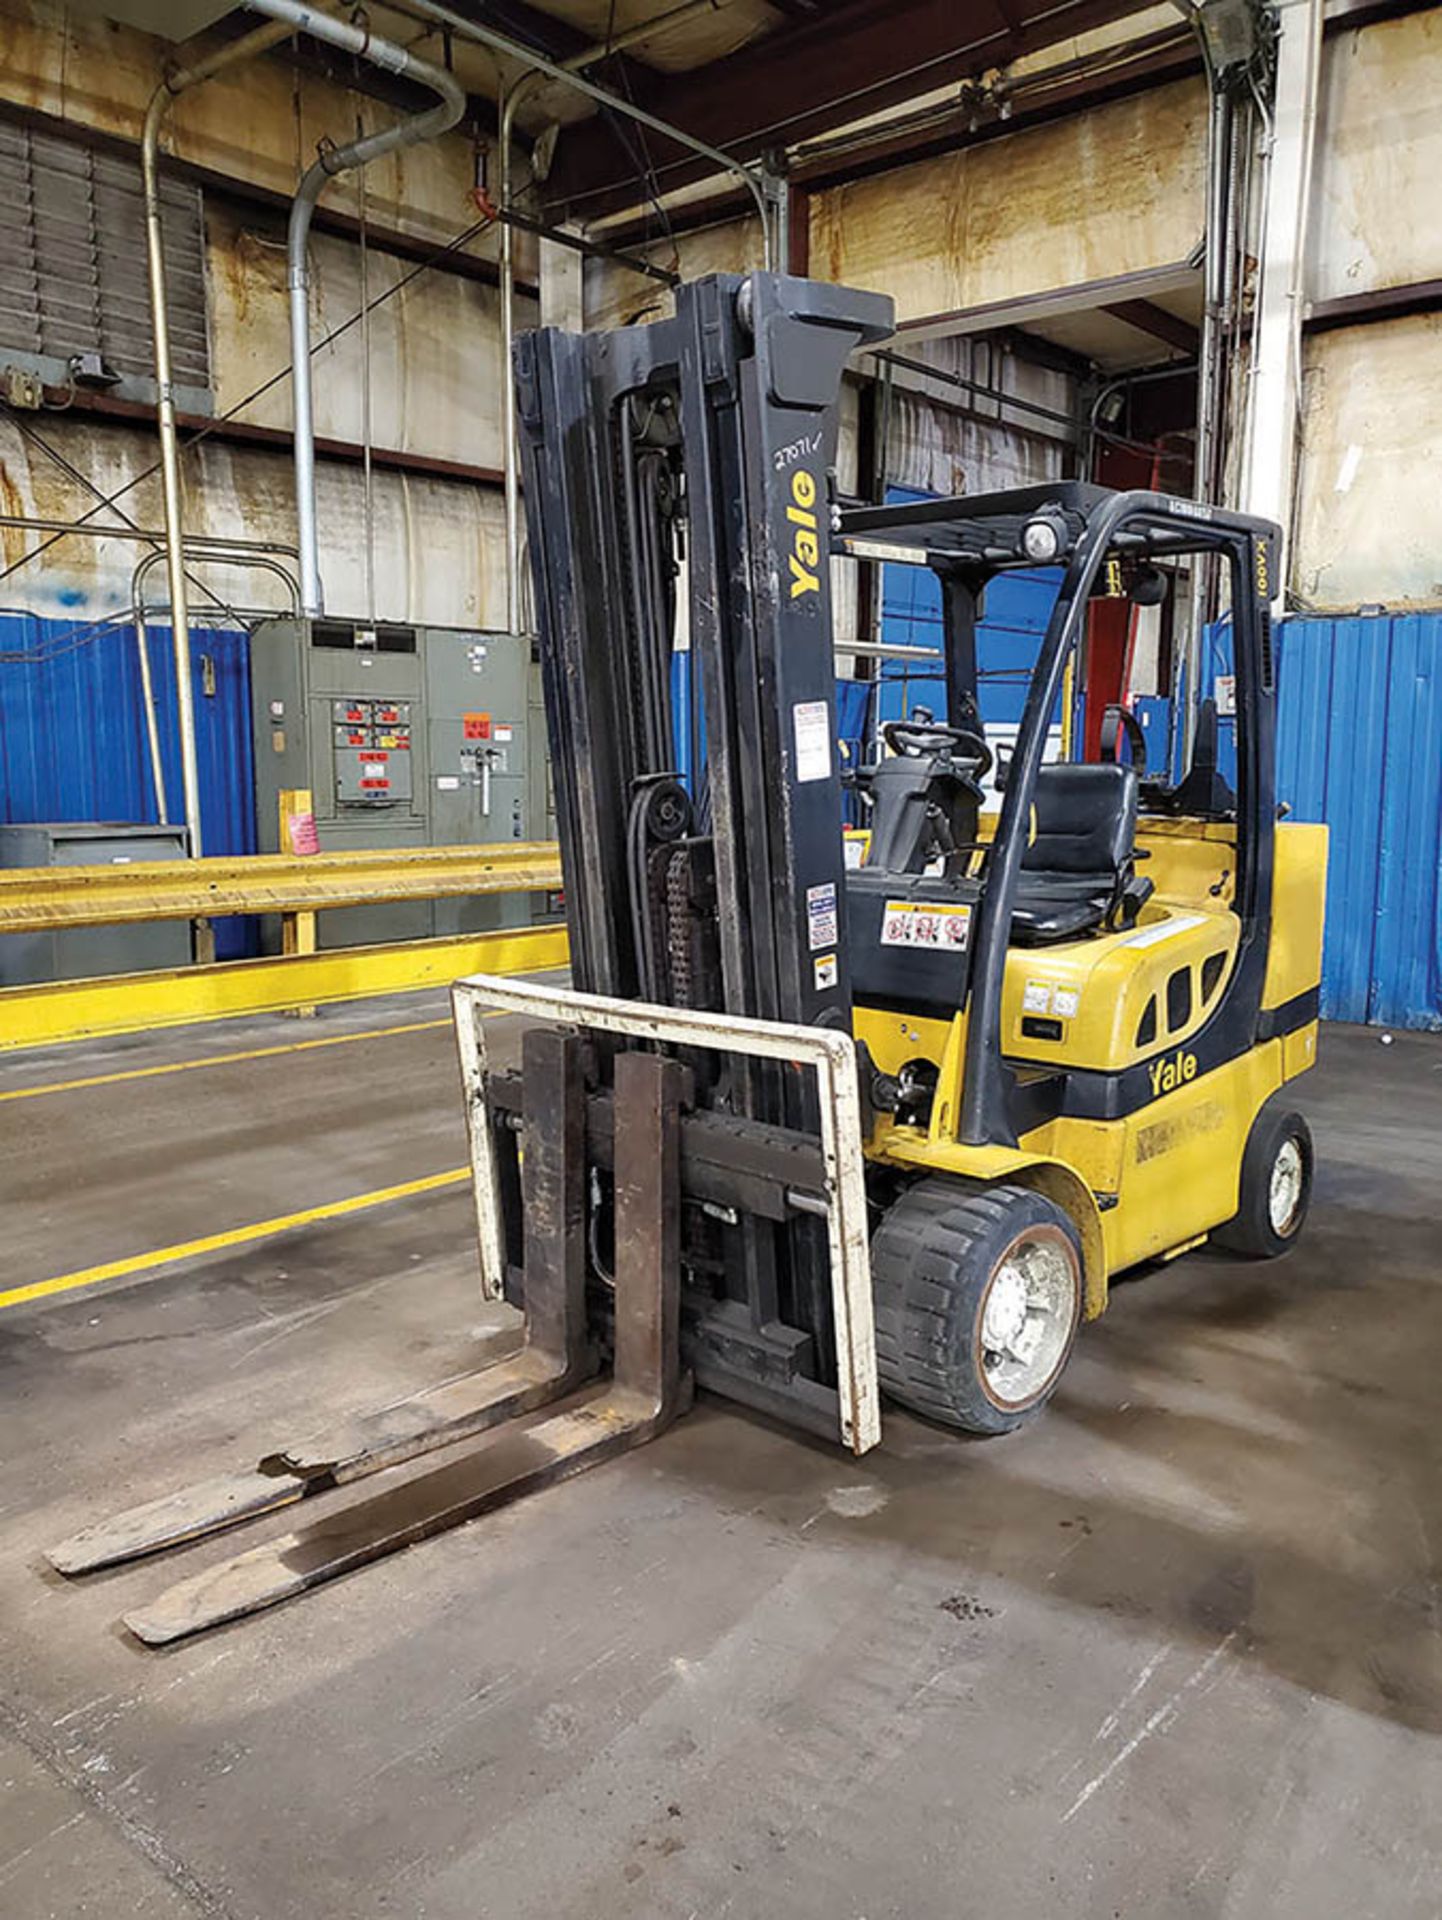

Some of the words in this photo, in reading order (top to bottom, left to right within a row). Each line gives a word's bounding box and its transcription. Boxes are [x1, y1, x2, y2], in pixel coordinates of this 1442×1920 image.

[786, 470, 820, 599] Yale
[1256, 540, 1268, 597] 100VX
[1149, 1051, 1197, 1096] Yale
